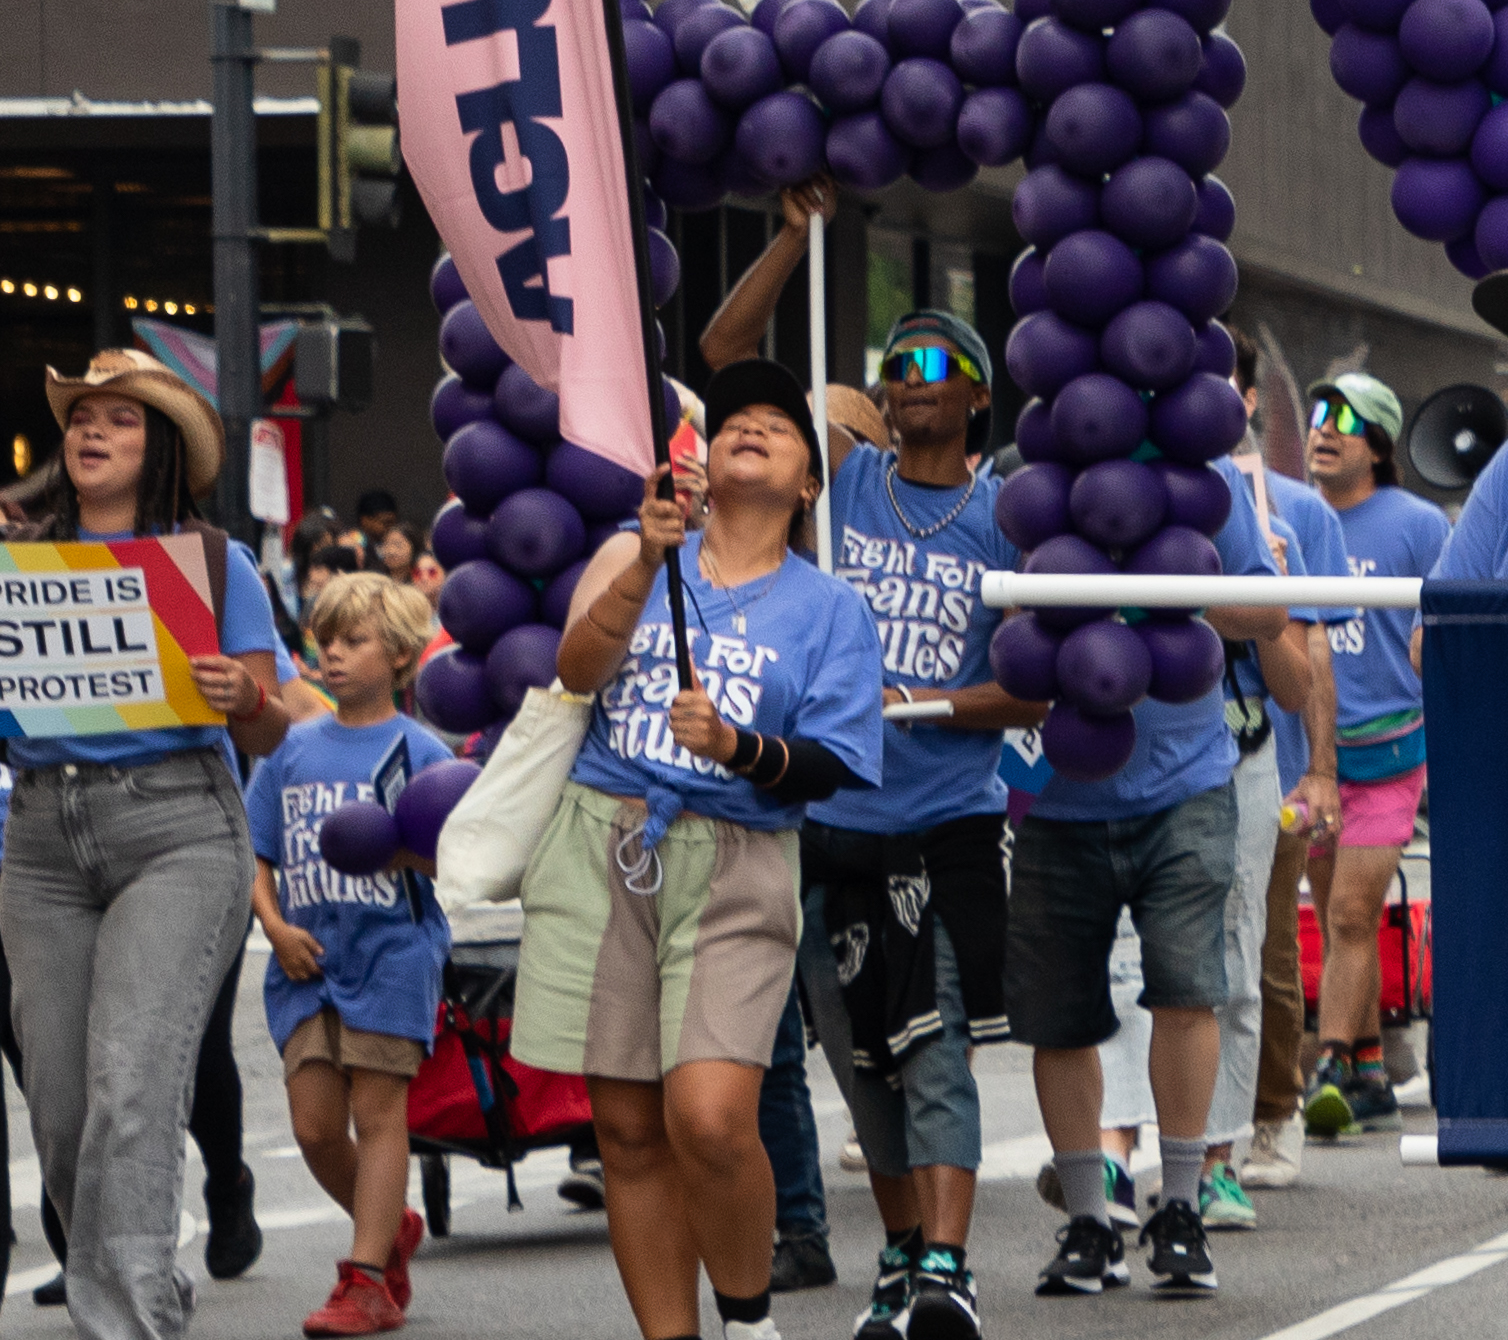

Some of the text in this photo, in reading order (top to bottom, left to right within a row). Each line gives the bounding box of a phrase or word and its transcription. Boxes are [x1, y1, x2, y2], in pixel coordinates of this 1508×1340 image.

[105, 576, 142, 603] IS
[926, 551, 988, 594] For
[0, 616, 148, 659] STILL
[704, 632, 780, 679] For
[877, 619, 966, 683] ures
[0, 668, 154, 702] PROTEST
